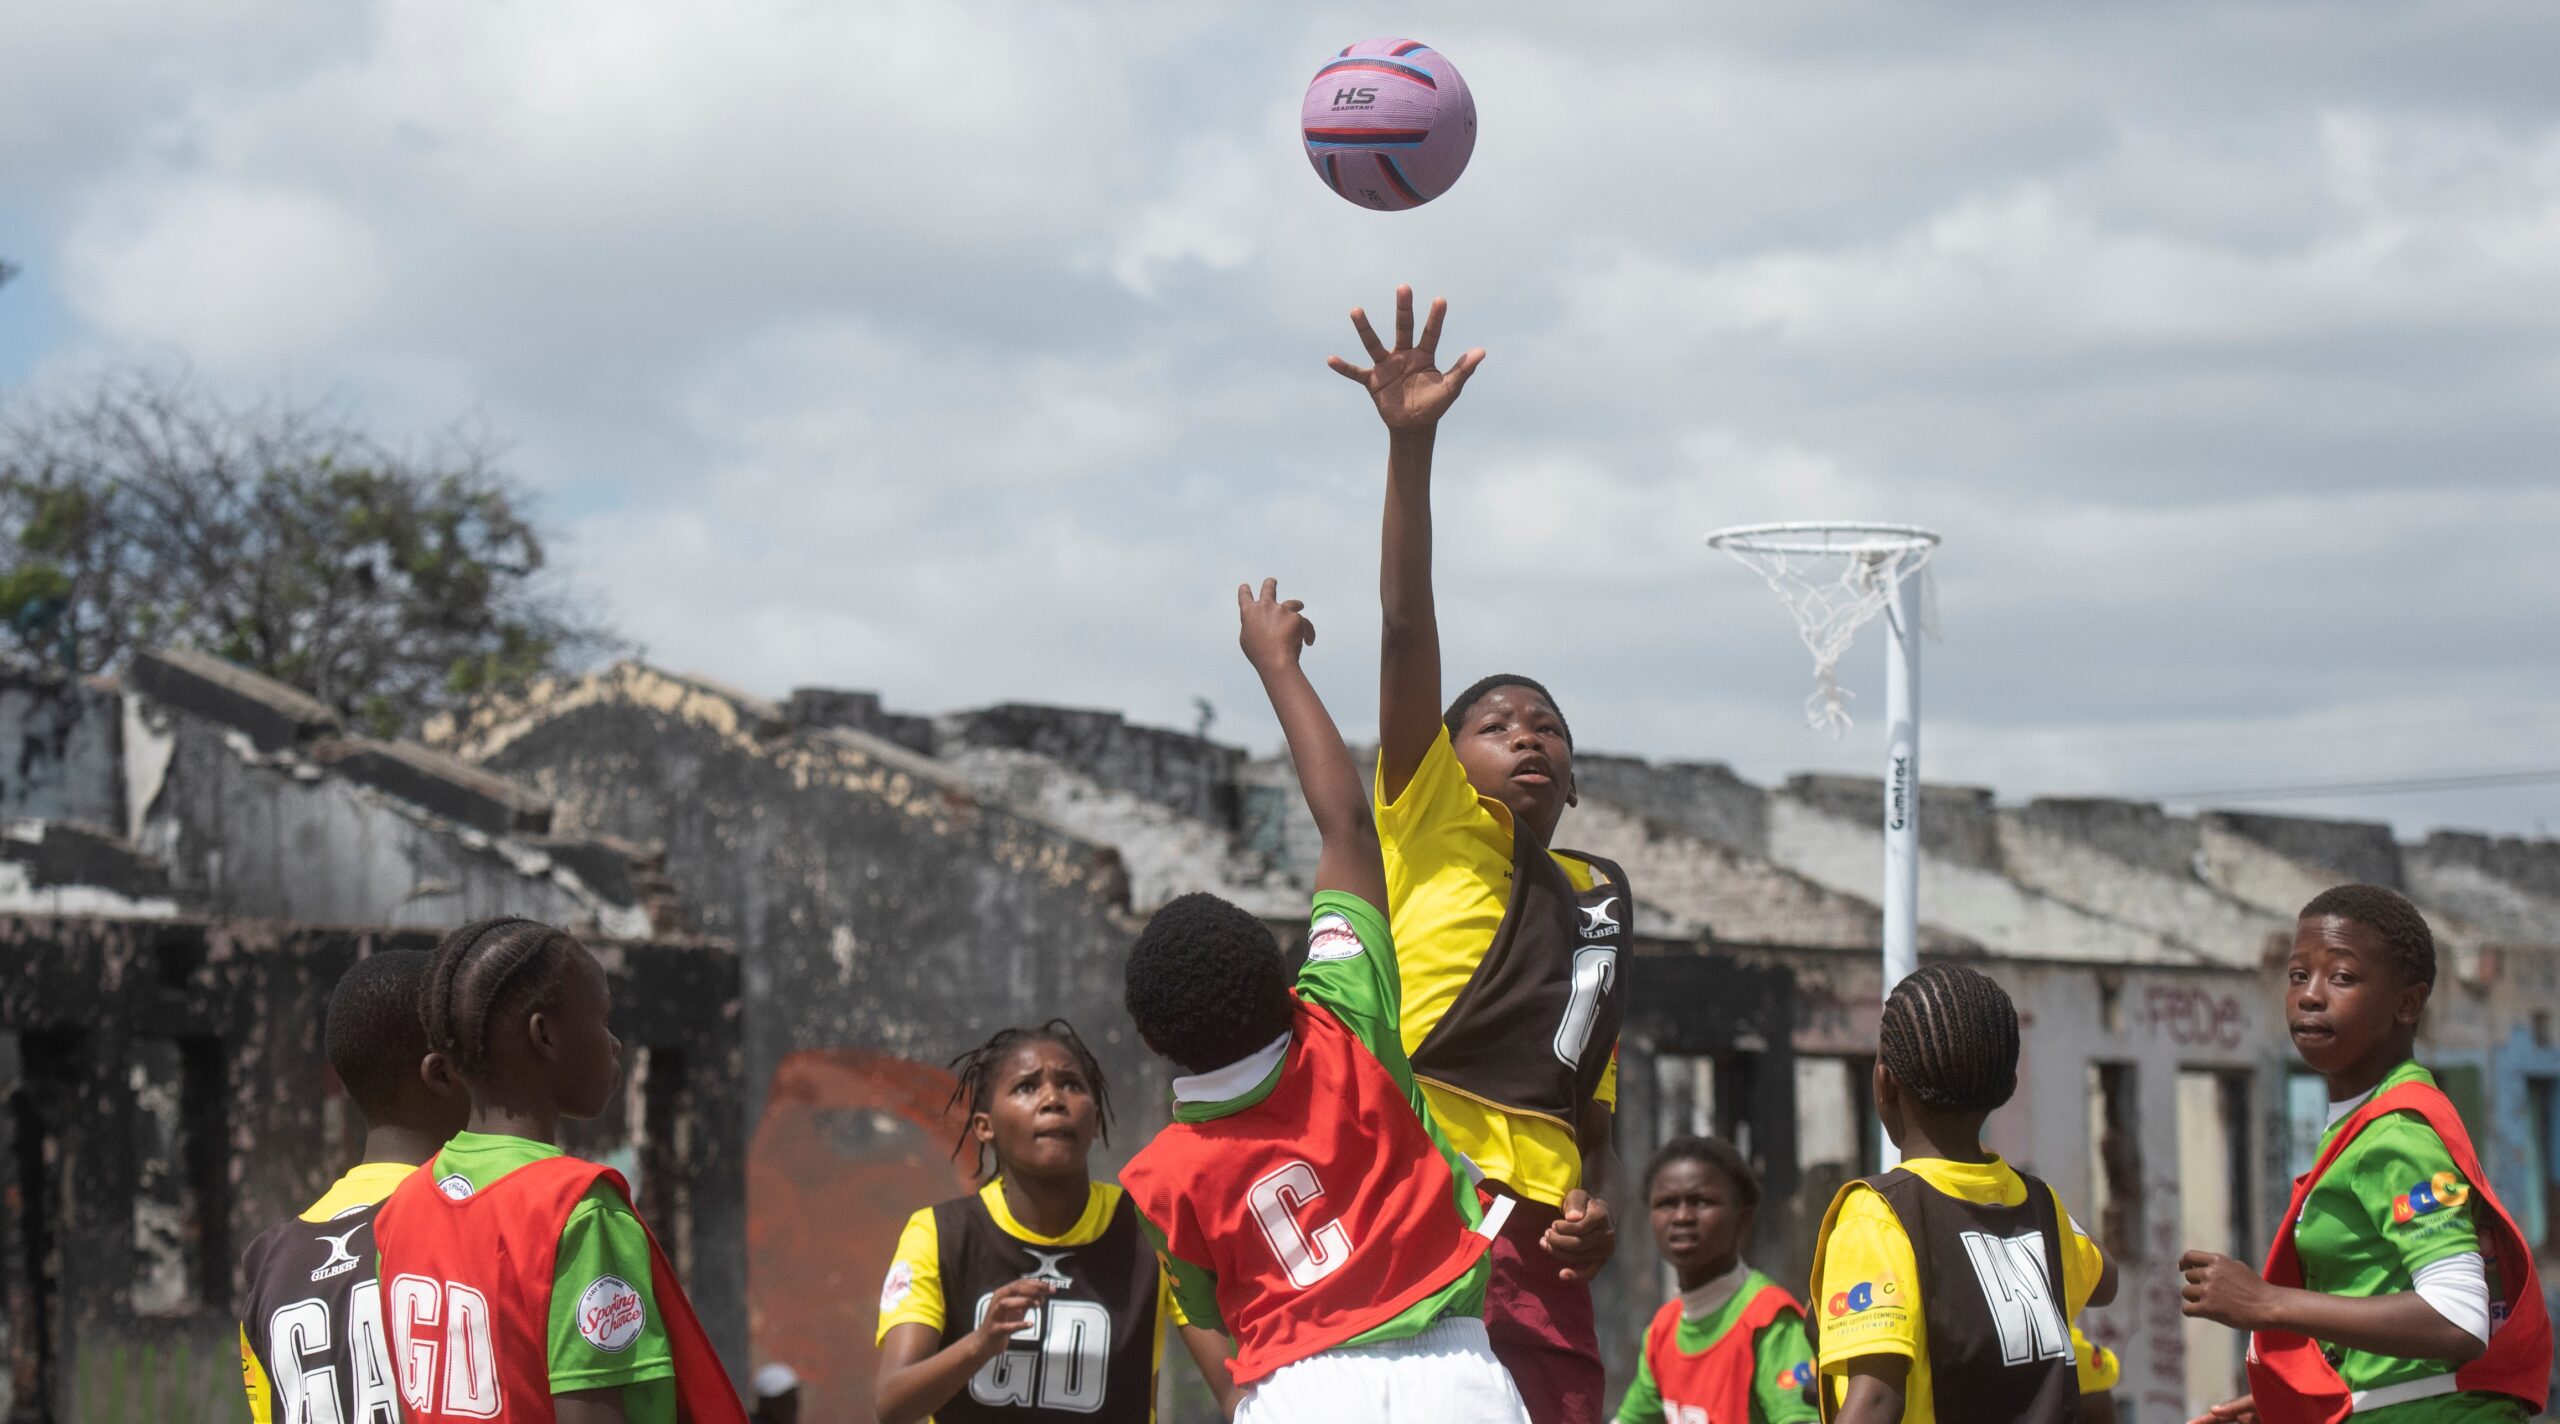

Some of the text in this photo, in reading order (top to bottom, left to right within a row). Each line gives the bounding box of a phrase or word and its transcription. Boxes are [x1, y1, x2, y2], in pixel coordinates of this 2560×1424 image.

[1333, 87, 1378, 105] HS
[1248, 1161, 1354, 1290] C
[311, 1257, 360, 1282] GILBERT
[582, 1293, 637, 1335] Sporting
[586, 1286, 600, 1301] STAY
[391, 1273, 502, 1419] GD
[599, 1309, 642, 1341] Chance
[270, 1279, 400, 1424] GA
[968, 1291, 1111, 1414] GD
